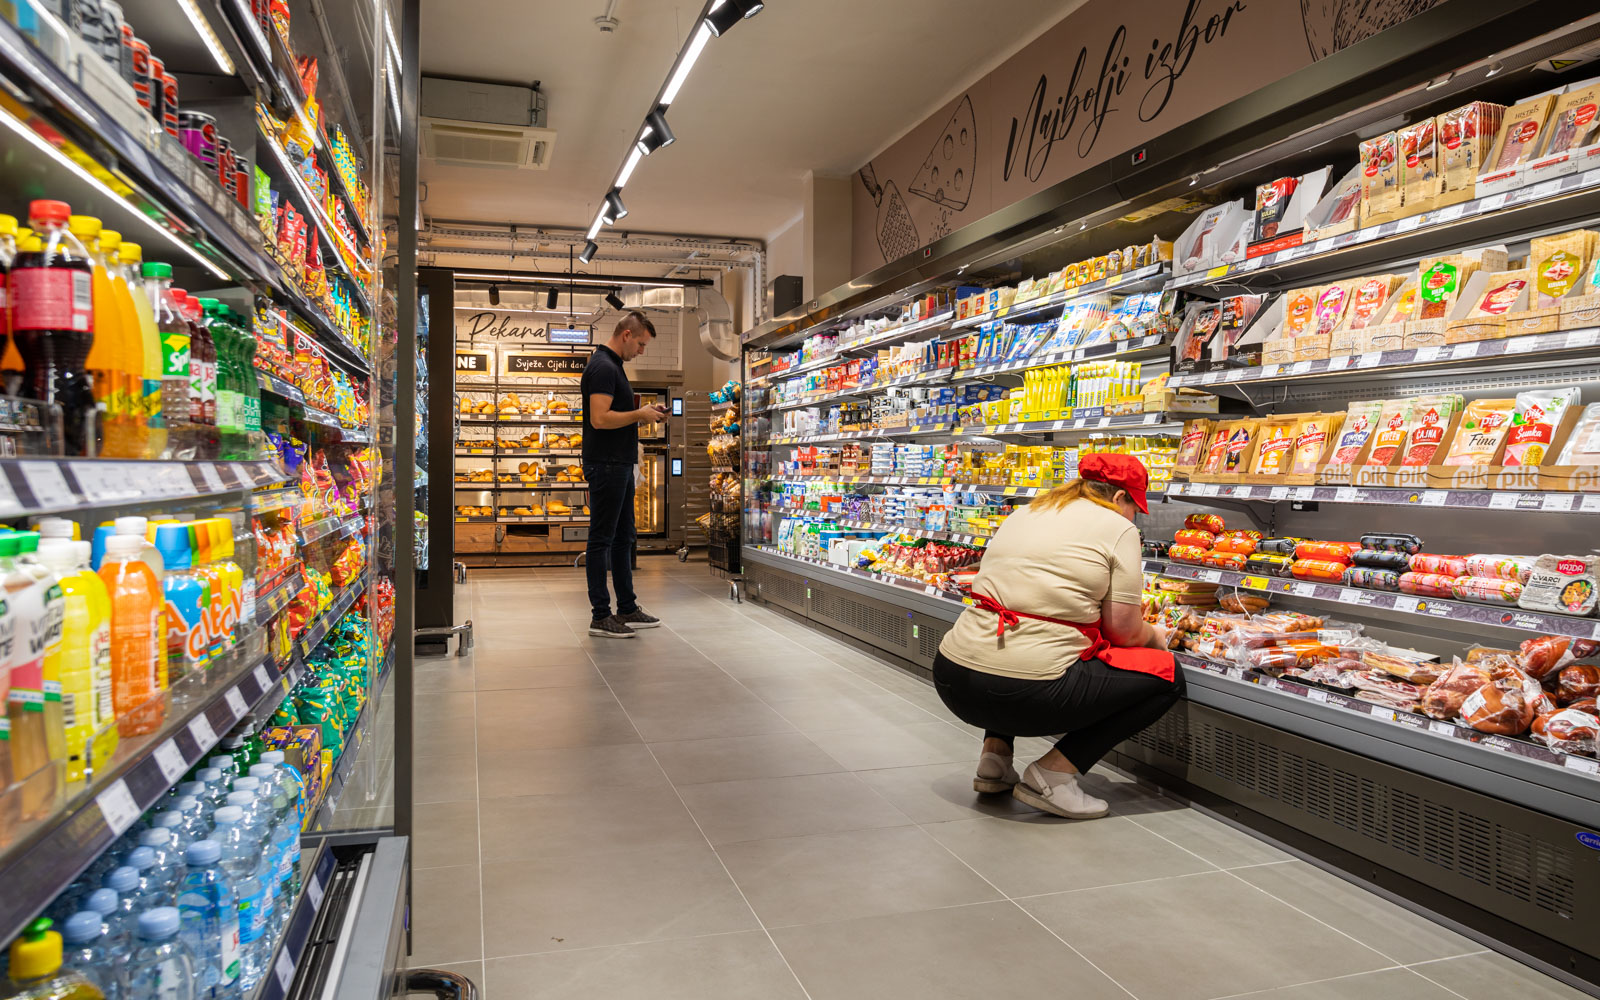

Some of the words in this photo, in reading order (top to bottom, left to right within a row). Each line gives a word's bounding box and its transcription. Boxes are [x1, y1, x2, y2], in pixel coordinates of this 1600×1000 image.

[1003, 25, 1132, 182] Najbolji
[1139, 0, 1247, 122] izbor
[468, 312, 546, 341] Pekara
[516, 358, 545, 371] Svježe.
[547, 360, 567, 372] Cijeli
[1422, 412, 1438, 424] pik
[1416, 428, 1437, 439] ČAJNA
[1469, 433, 1497, 446] Fina
[1325, 464, 1350, 484] pik
[1361, 466, 1387, 484] pik
[1398, 466, 1427, 486] pik
[1457, 466, 1488, 488] pik
[1503, 466, 1538, 489] pik
[1558, 563, 1583, 572] VAJDA
